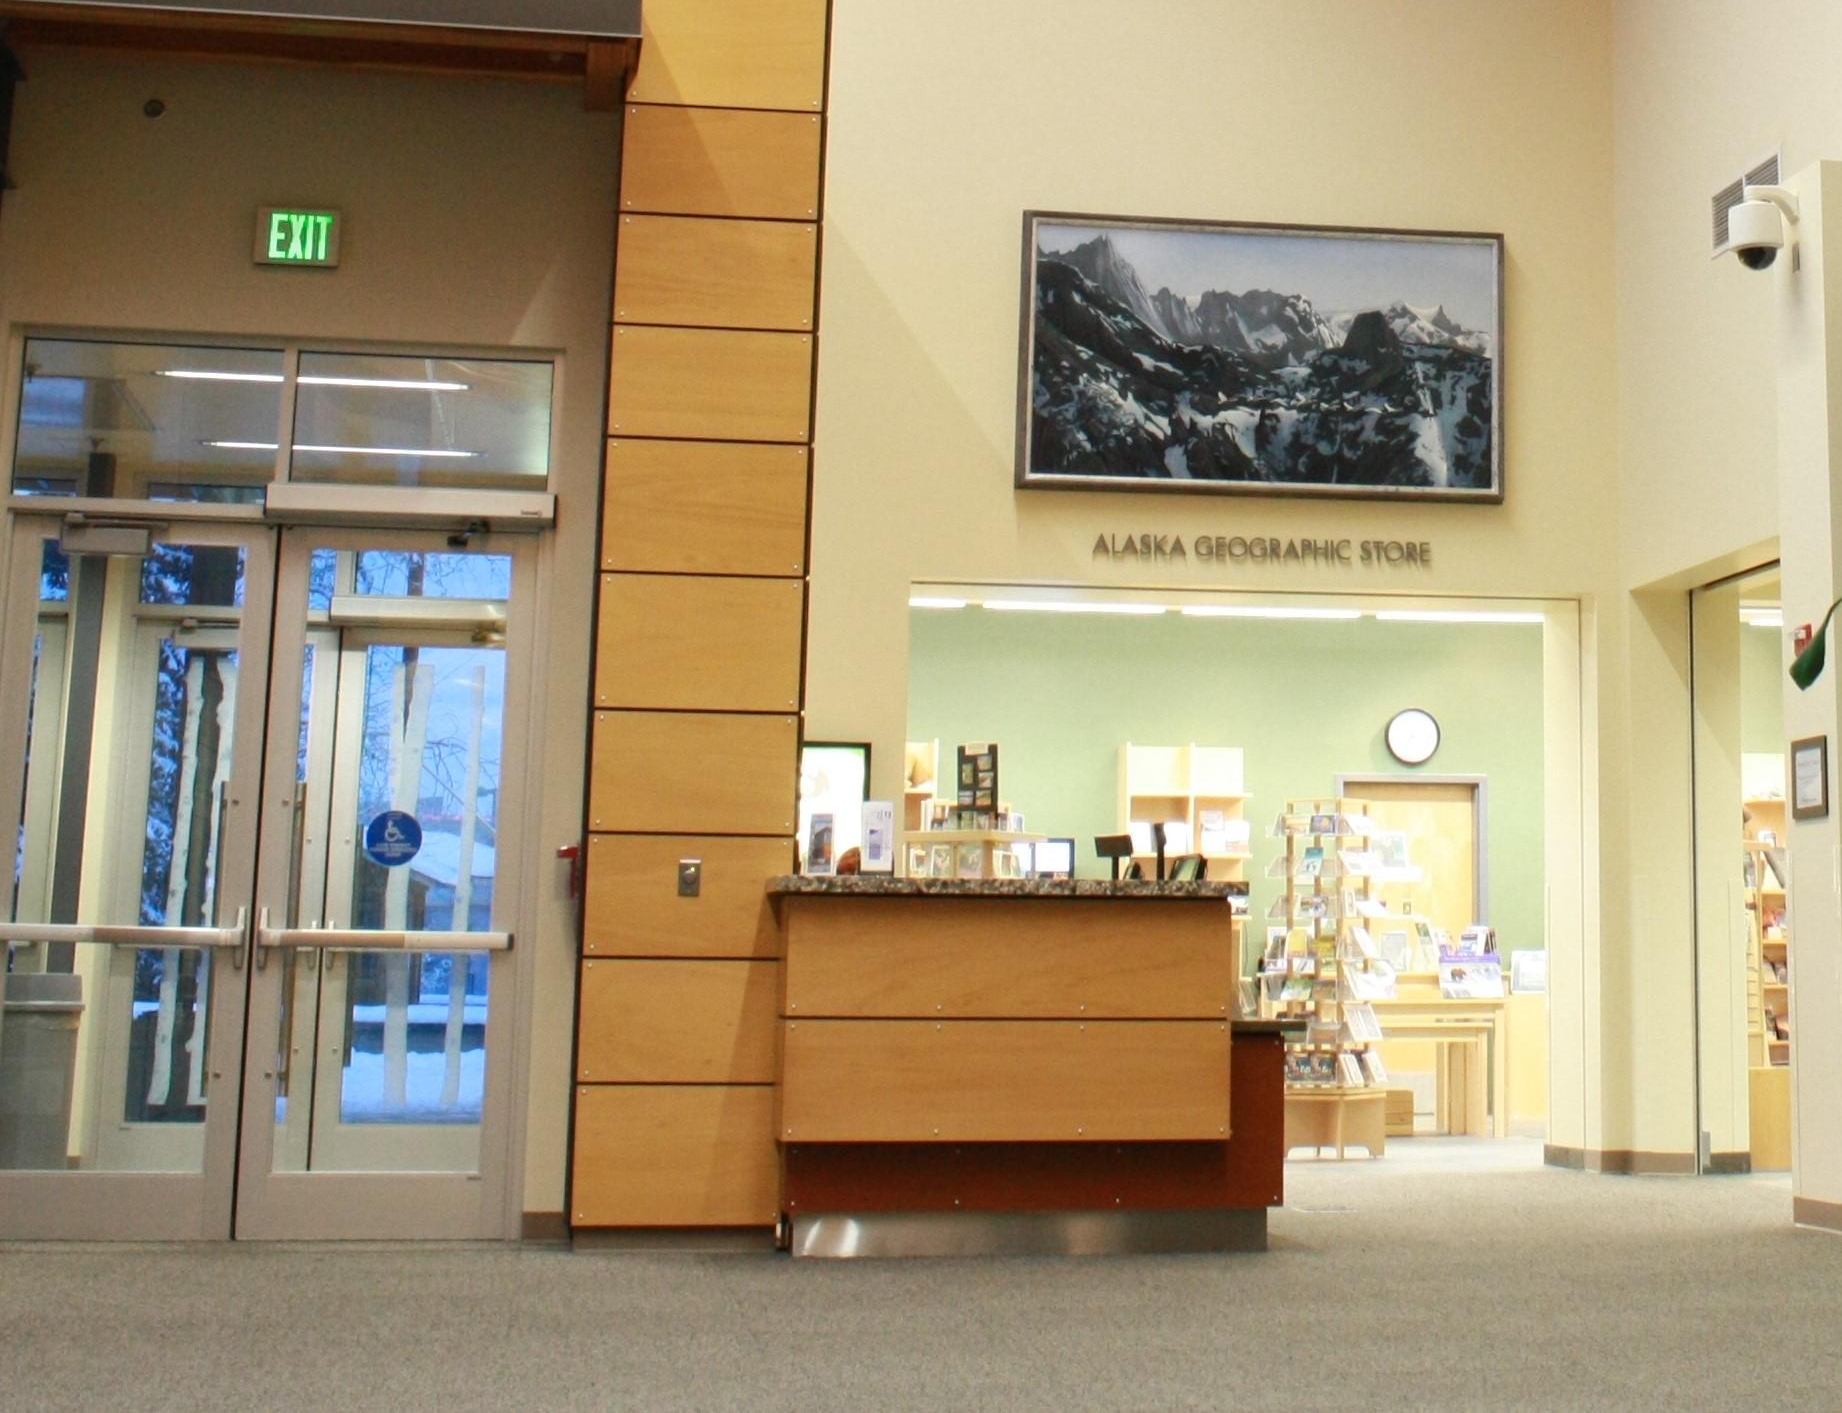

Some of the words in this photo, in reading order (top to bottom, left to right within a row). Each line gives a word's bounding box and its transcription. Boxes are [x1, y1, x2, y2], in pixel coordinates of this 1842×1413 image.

[268, 212, 334, 261] EXIT
[1092, 533, 1187, 557] ALASKA
[1194, 535, 1351, 562] GEOGRAPHIC
[1359, 539, 1432, 564] STORE
